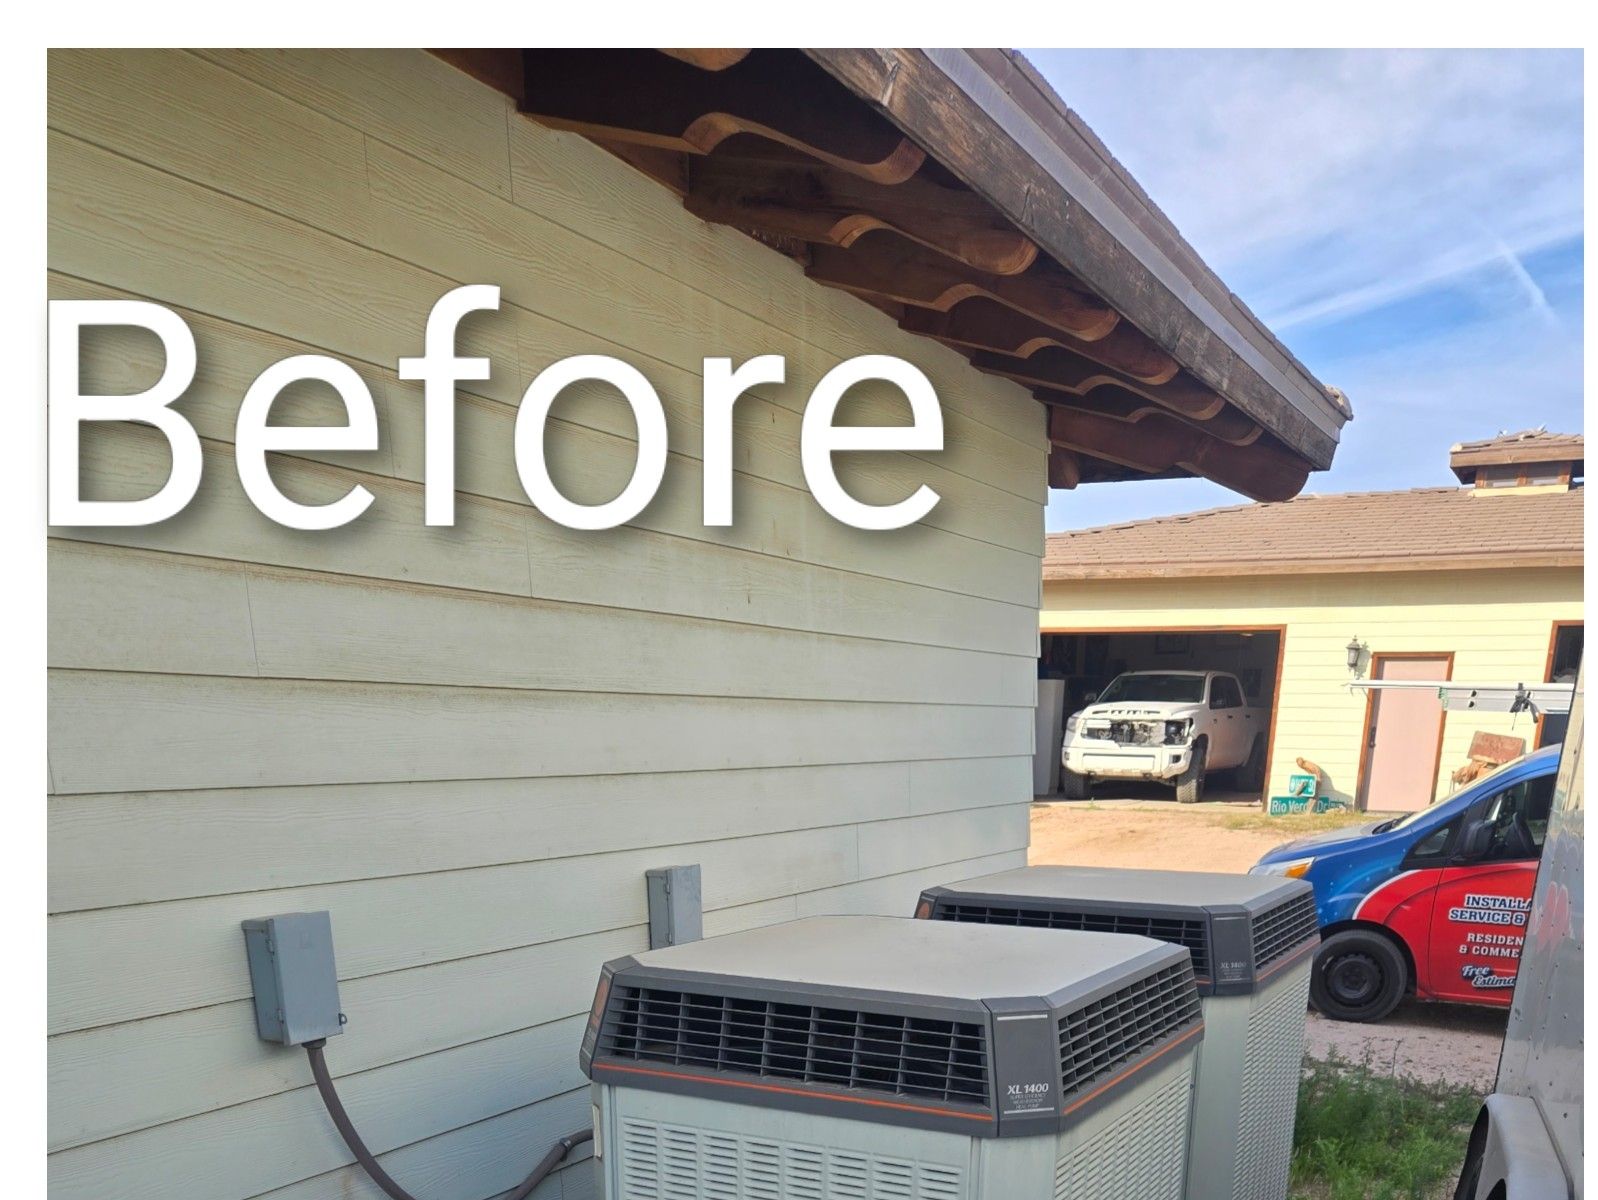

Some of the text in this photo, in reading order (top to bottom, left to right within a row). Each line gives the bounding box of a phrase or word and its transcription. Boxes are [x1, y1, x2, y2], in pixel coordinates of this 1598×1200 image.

[1272, 800, 1287, 813] Rio
[1449, 908, 1526, 925] SERVICE &
[1467, 932, 1524, 946] RESIDEN
[1459, 945, 1520, 958] & COMME
[1462, 965, 1490, 977] Free
[1007, 1082, 1049, 1095] XL 1400
